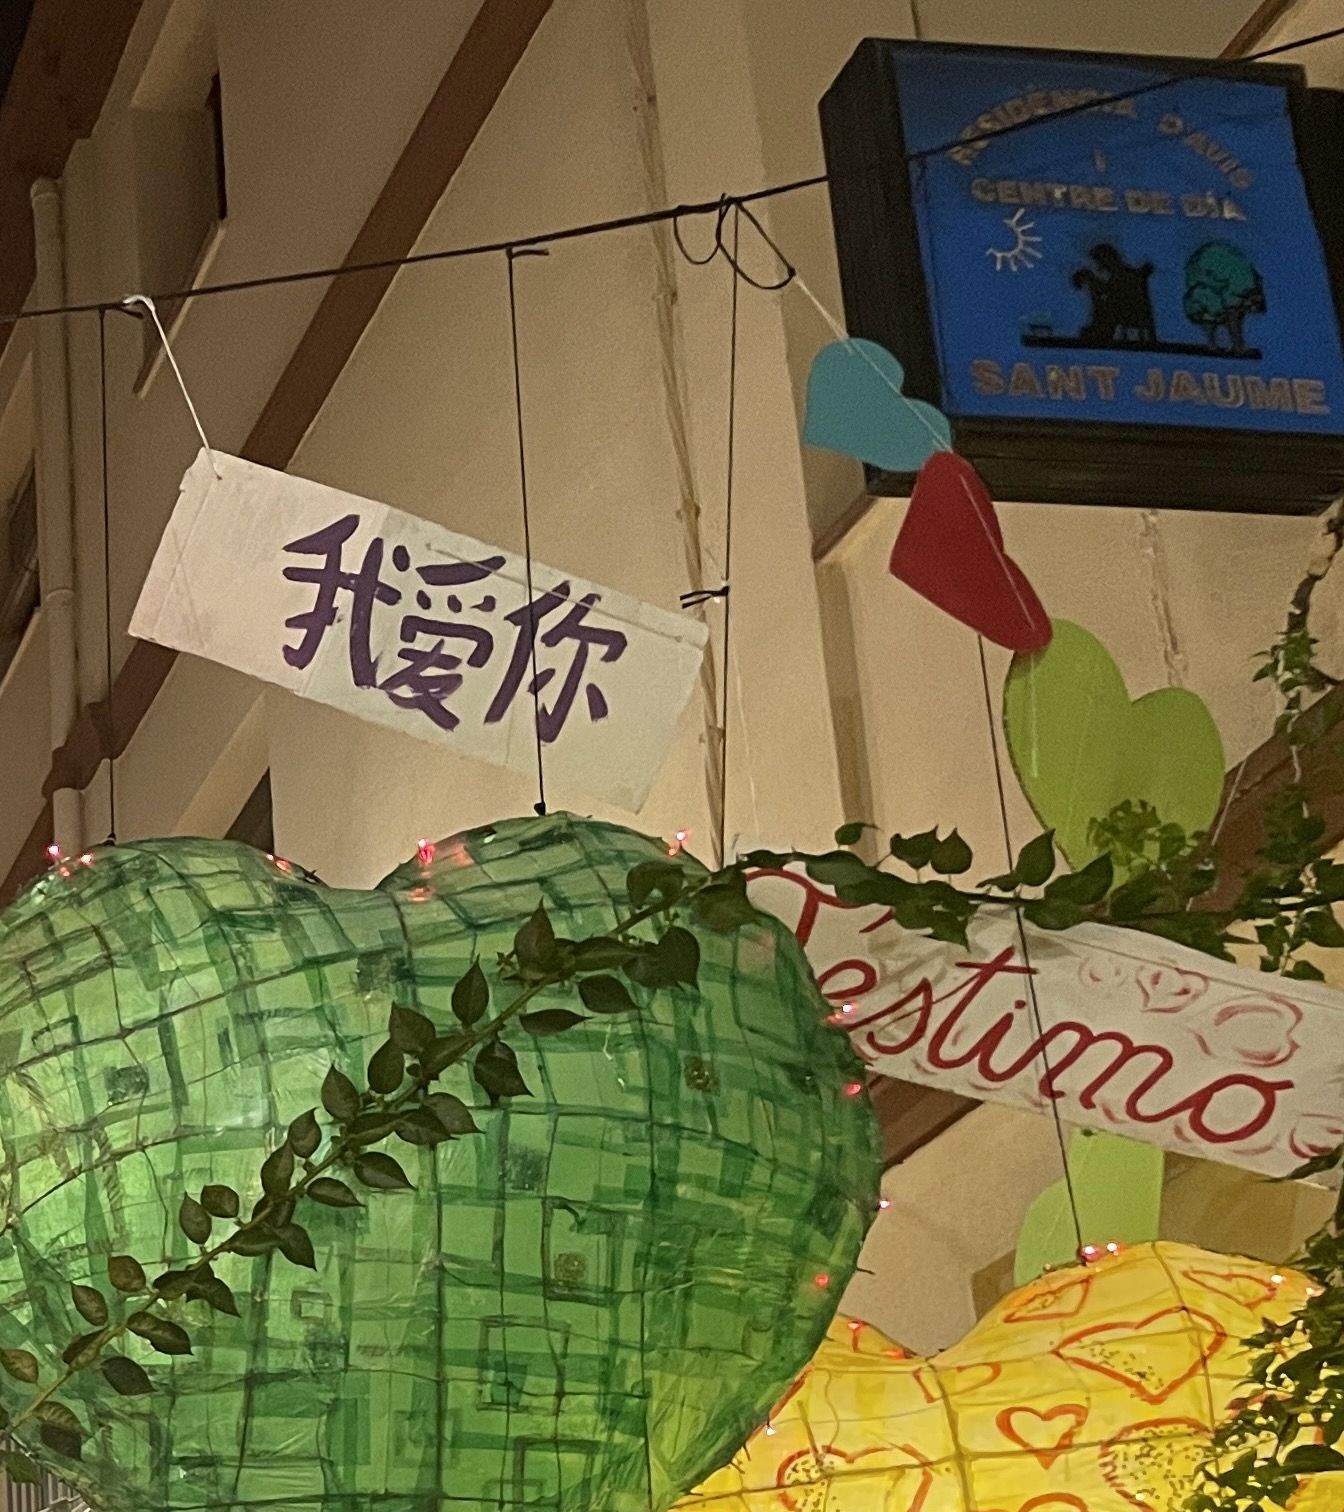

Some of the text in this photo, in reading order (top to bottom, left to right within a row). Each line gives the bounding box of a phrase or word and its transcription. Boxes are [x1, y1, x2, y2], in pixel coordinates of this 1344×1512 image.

[971, 178, 1118, 213] CENTRE
[1124, 188, 1175, 216] DE
[969, 359, 1330, 416] SANT JAUME
[281, 514, 629, 746] 我爱你
